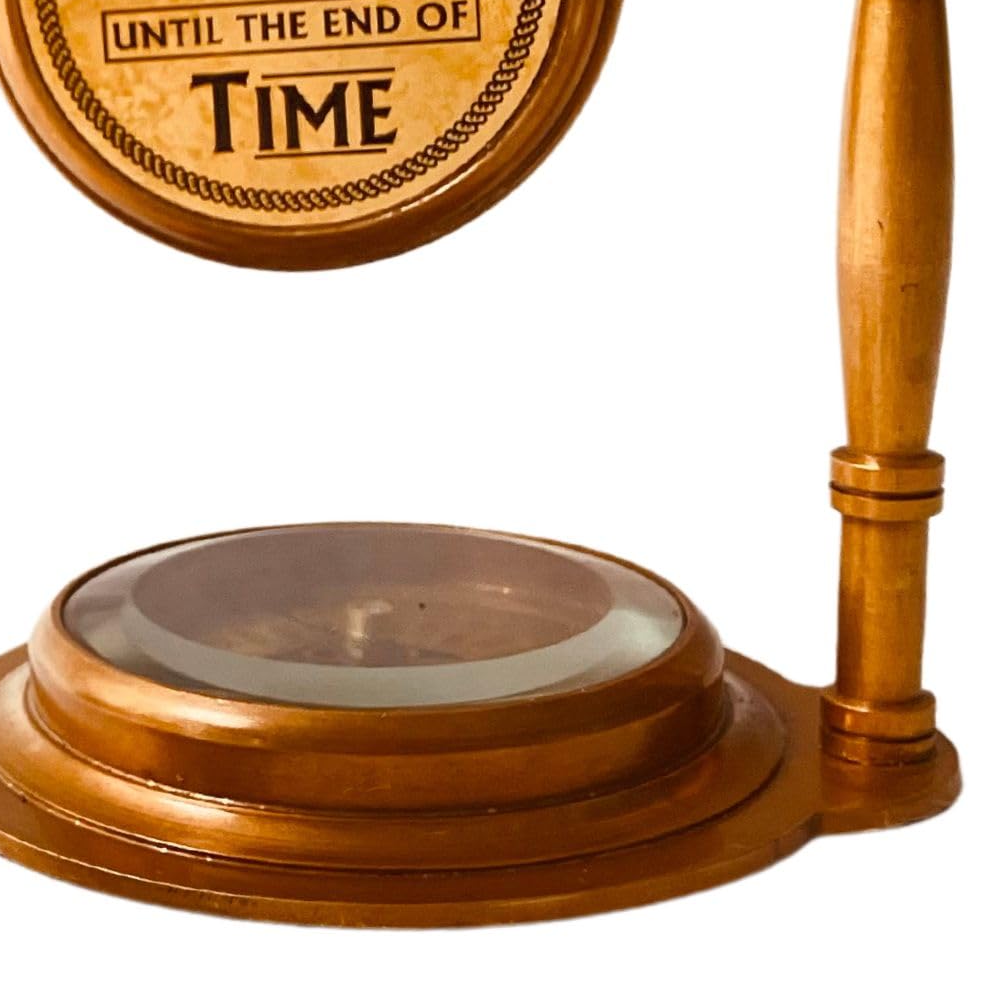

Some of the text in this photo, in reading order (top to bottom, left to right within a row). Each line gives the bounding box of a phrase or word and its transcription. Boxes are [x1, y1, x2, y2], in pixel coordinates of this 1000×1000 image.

[112, 0, 470, 52] UNTIL THE END OF
[190, 71, 400, 154] TIME
